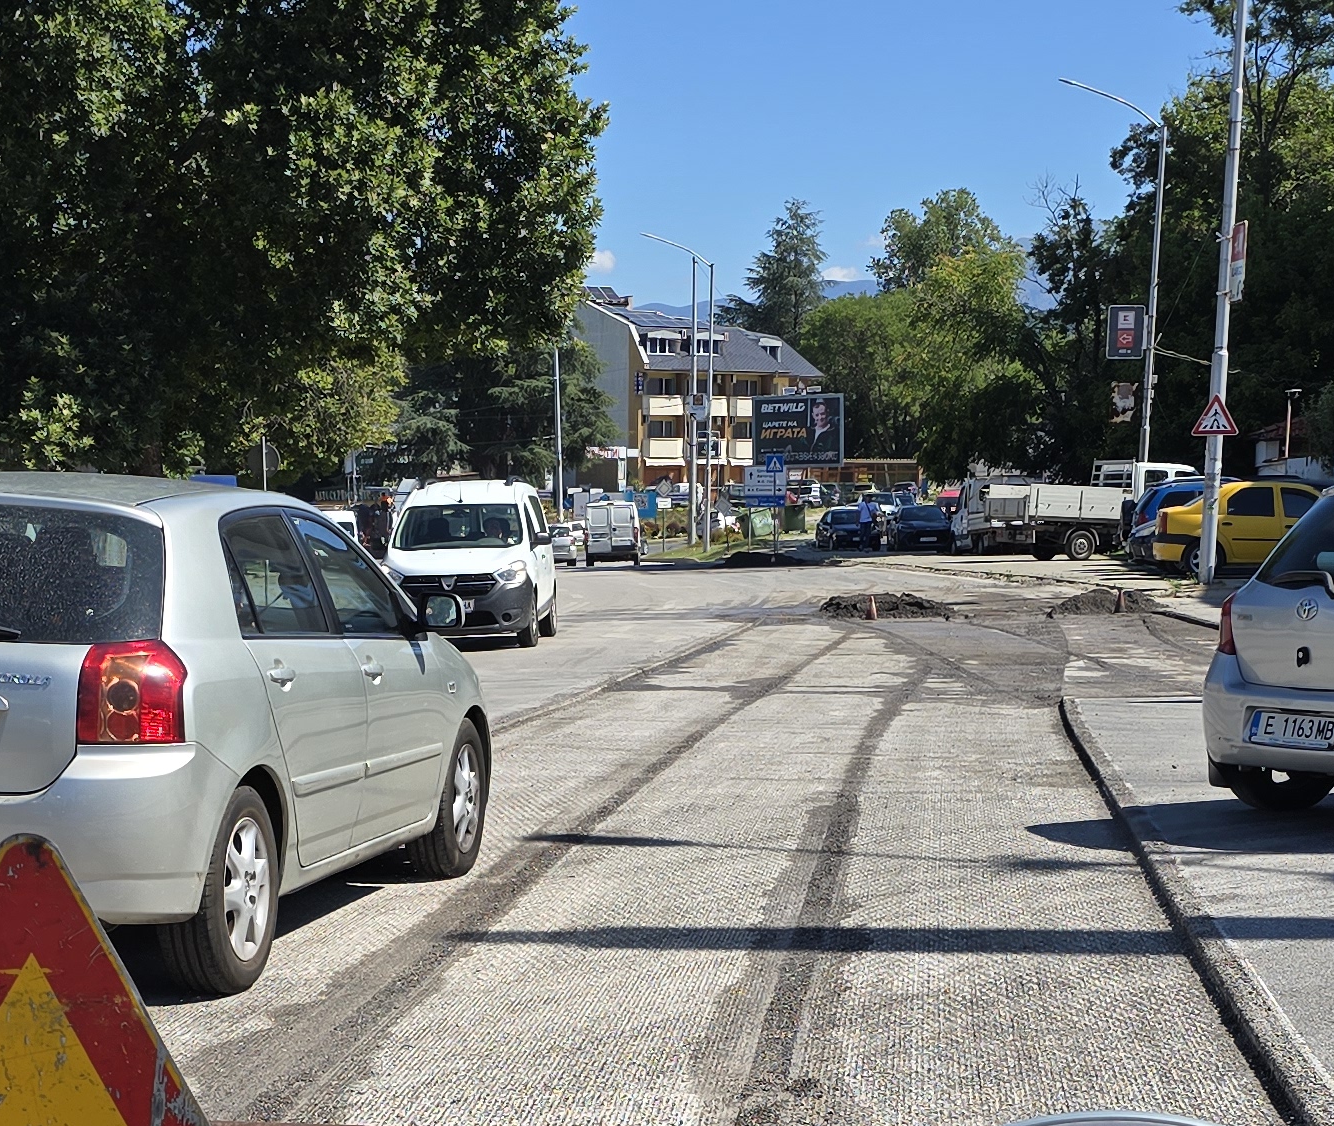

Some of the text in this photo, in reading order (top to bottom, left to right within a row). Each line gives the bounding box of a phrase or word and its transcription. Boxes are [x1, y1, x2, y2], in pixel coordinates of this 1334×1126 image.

[761, 403, 806, 413] BETWILD
[761, 428, 807, 440] ИГРАТА
[1263, 716, 1276, 735] E
